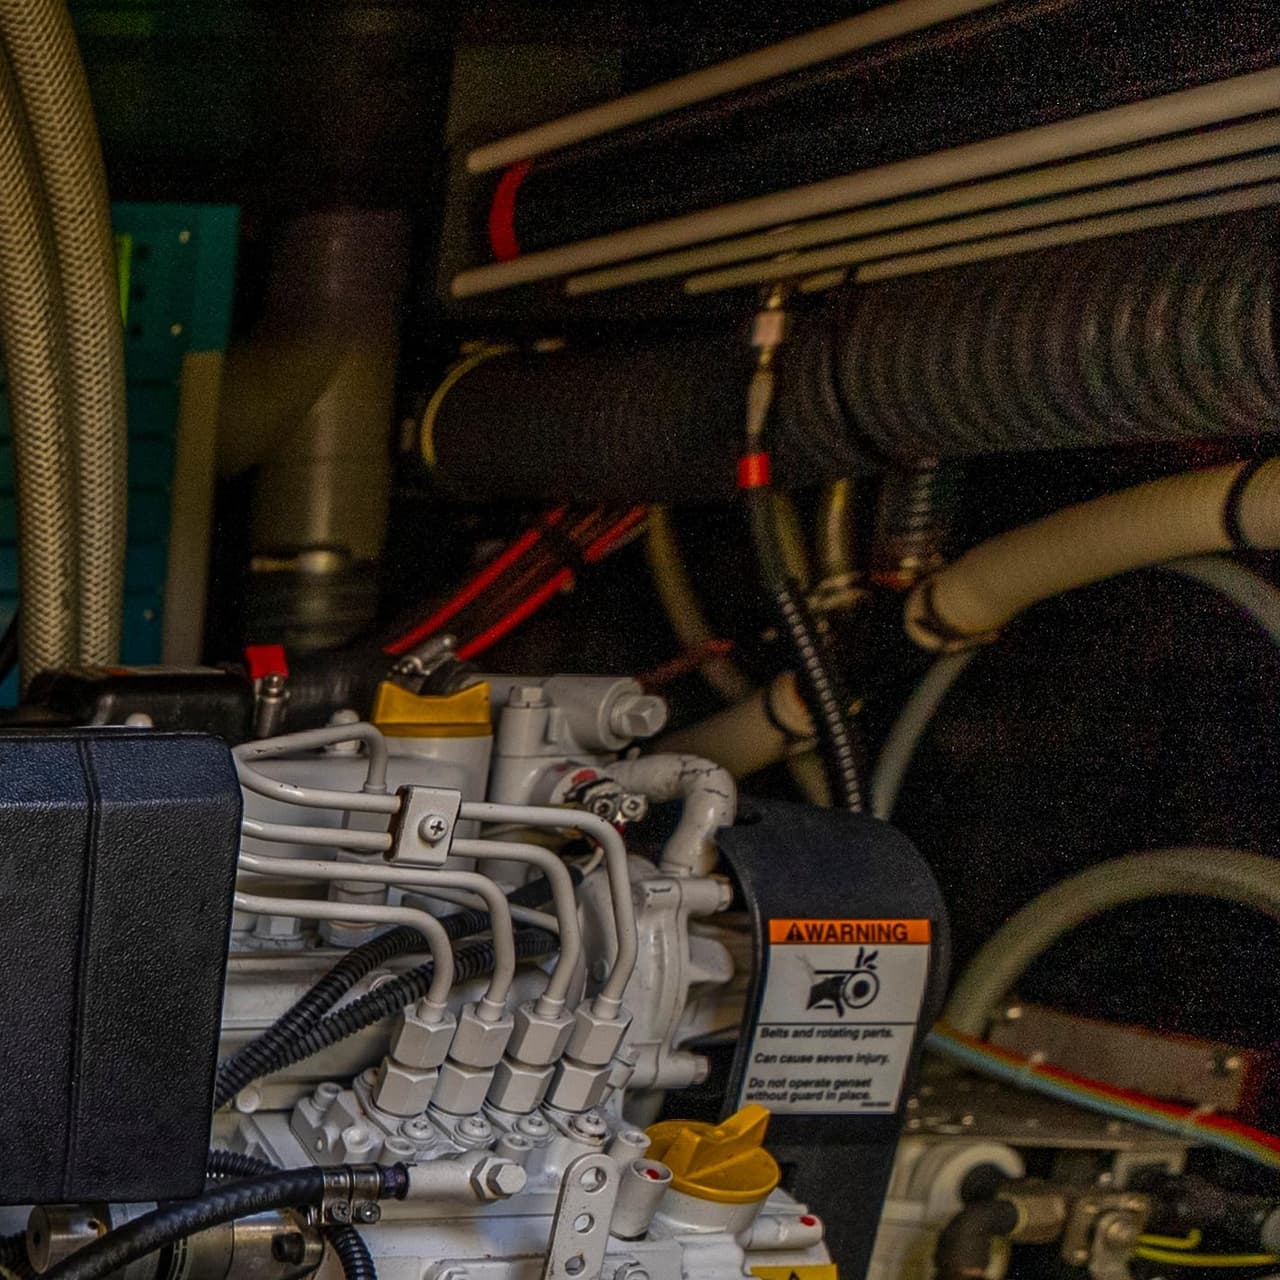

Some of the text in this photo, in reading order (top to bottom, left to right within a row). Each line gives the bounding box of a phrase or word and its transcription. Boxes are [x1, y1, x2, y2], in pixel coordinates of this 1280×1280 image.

[805, 922, 908, 942] WARNING
[759, 1027, 893, 1041] Belts and rotating parts.
[754, 1052, 888, 1065] Can cause severe injury.
[748, 1077, 872, 1091] Do not operate genset
[745, 1090, 870, 1103] without guard in place.
